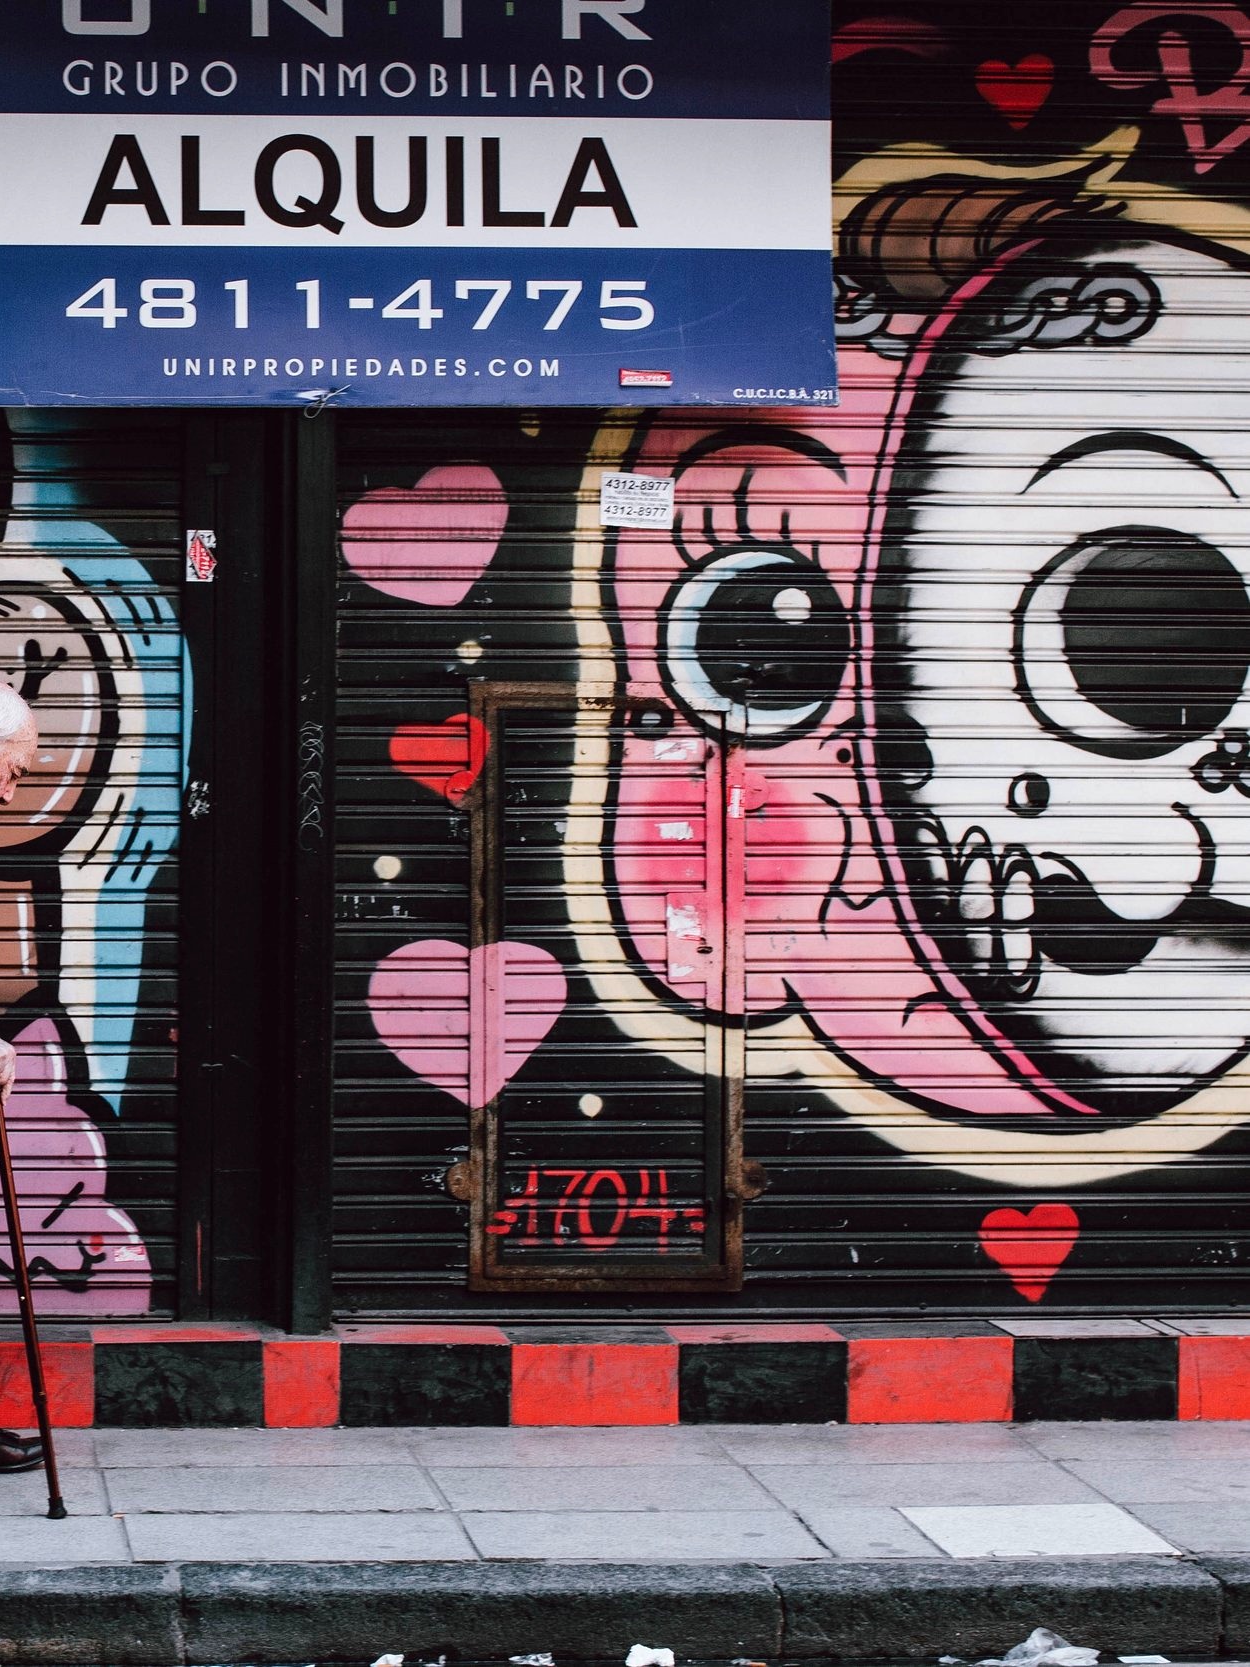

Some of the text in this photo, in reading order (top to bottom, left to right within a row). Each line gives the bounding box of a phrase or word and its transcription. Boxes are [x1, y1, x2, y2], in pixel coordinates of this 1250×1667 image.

[62, 59, 653, 100] GRUPO INMOBILIARIO
[80, 133, 639, 235] ALQUILA
[65, 278, 655, 331] 4811-4775
[162, 358, 561, 378] UNIRPROPIEDADES.COM
[812, 389, 834, 400] 321
[605, 478, 670, 492] 4312-8977
[603, 505, 667, 518] 4312-8977
